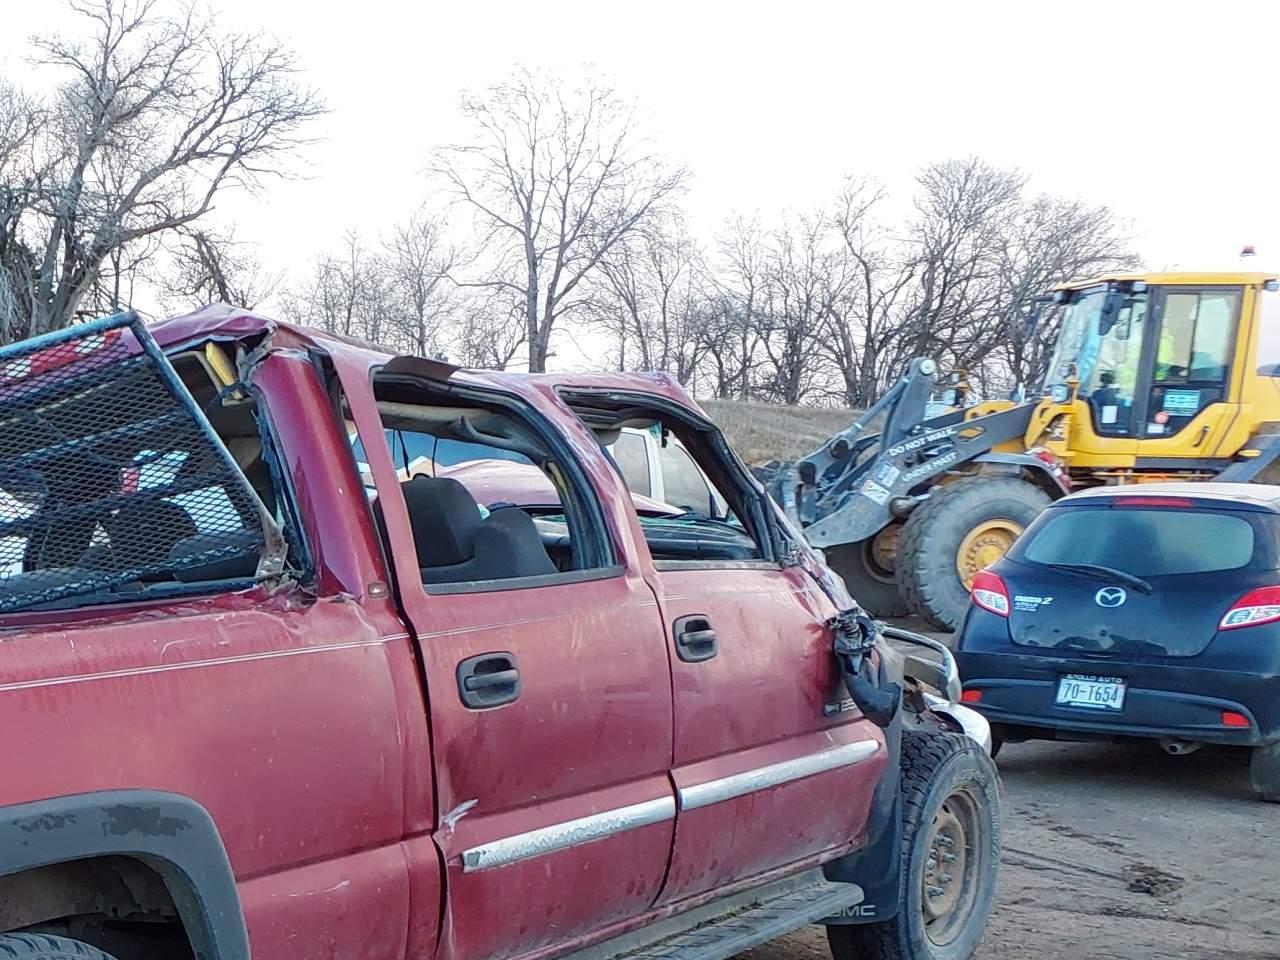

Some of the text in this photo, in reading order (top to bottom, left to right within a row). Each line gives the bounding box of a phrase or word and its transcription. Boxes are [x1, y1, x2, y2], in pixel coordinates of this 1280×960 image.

[889, 446, 905, 456] DO
[905, 437, 926, 451] NOT
[1063, 683, 1119, 703] 70-T654
